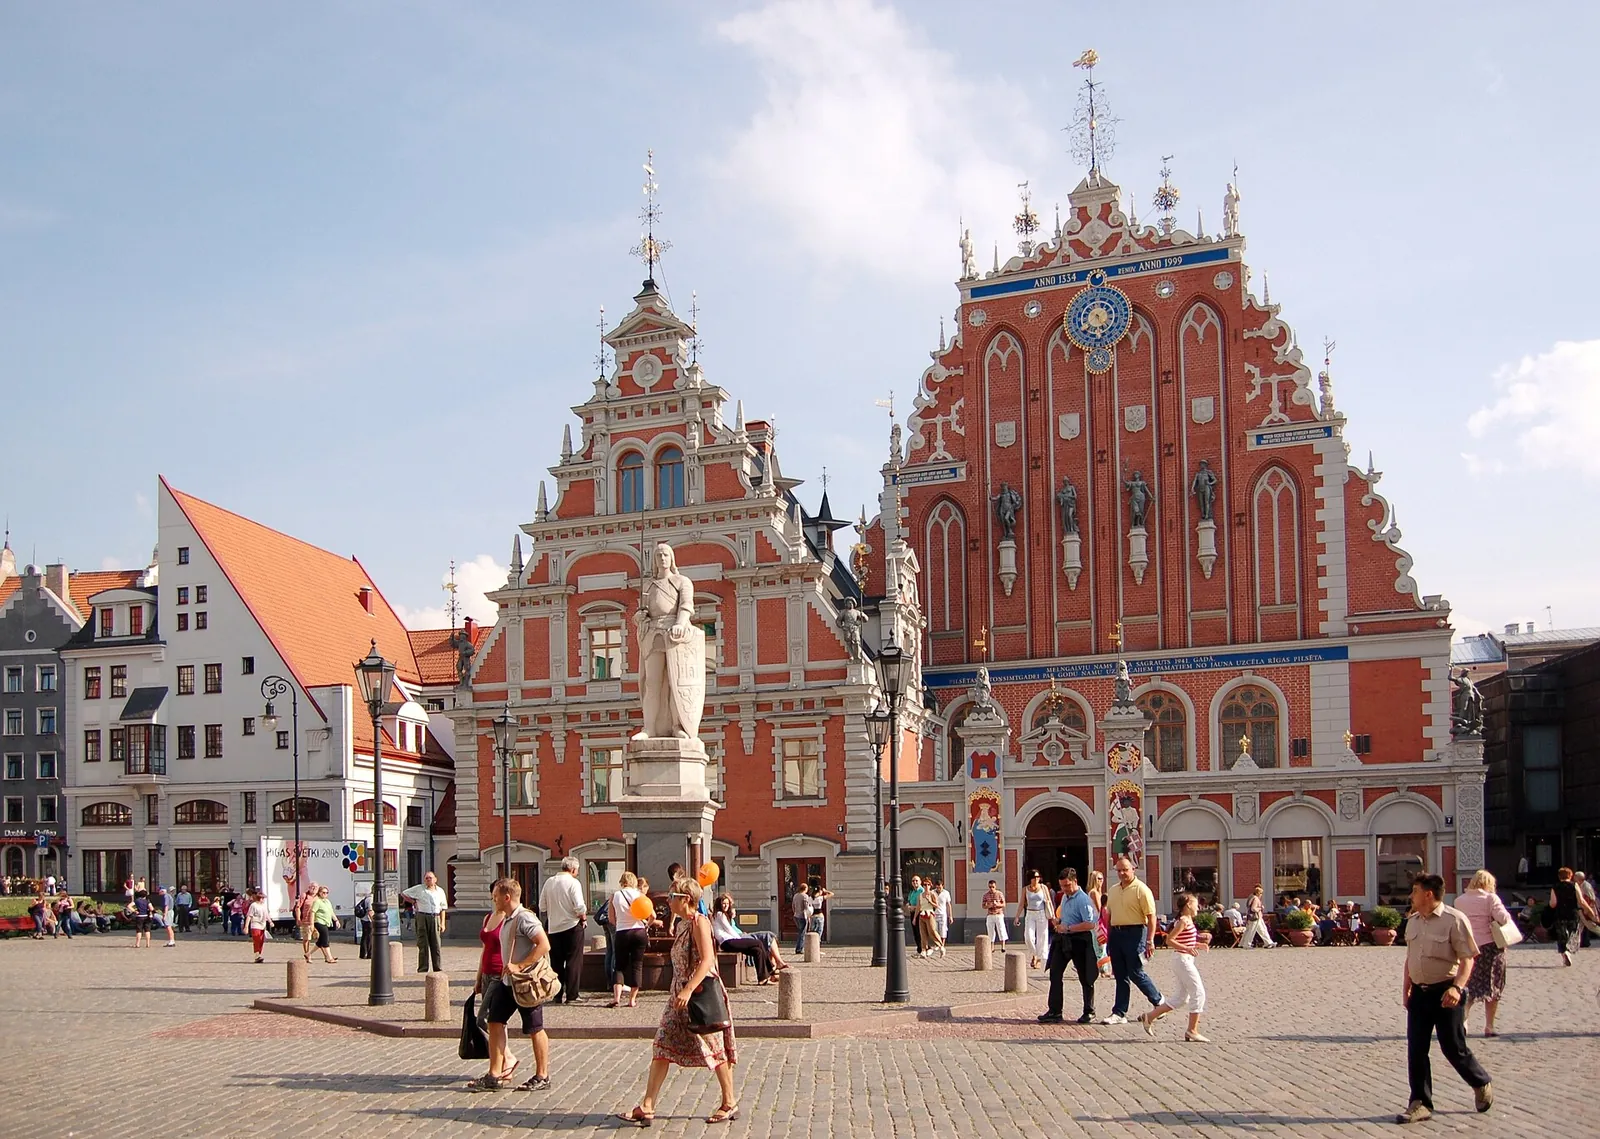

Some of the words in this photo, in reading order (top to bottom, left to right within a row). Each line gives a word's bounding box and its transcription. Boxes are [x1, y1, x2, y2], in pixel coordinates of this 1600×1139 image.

[1138, 259, 1161, 271] ANNO
[1164, 256, 1183, 267] 1999
[1034, 276, 1056, 288] ANNO
[1058, 273, 1077, 284] 1334
[1081, 669, 1103, 677] NAMU
[1156, 663, 1193, 672] PAMATIEM
[1093, 662, 1113, 670] NAMS
[1136, 659, 1171, 667] SAGRAUTS
[4, 829, 27, 837] Double
[39, 835, 46, 846] P
[321, 848, 340, 859] 2006
